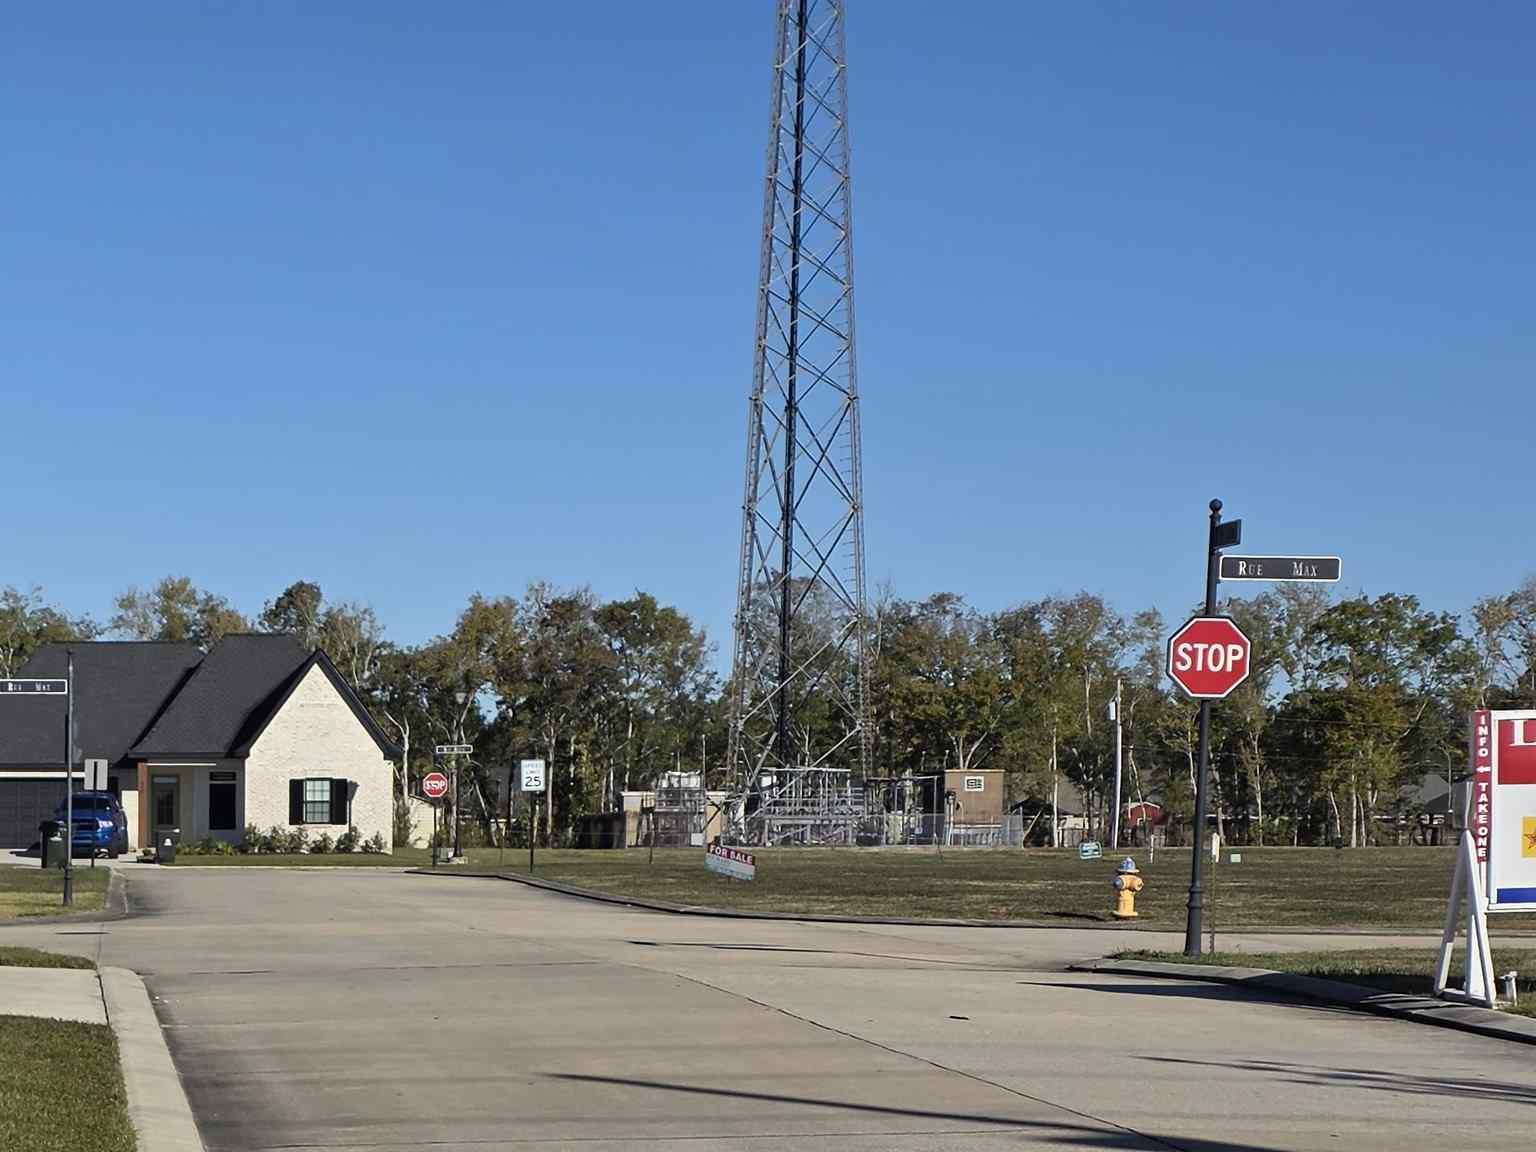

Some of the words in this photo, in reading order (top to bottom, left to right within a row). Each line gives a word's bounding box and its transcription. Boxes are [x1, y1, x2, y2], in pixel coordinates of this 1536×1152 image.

[1175, 642, 1244, 673] STOP
[1477, 715, 1489, 757] INFO
[424, 780, 446, 791] STOP
[525, 776, 541, 787] 25
[709, 844, 728, 859] FOR
[729, 850, 753, 865] SALE
